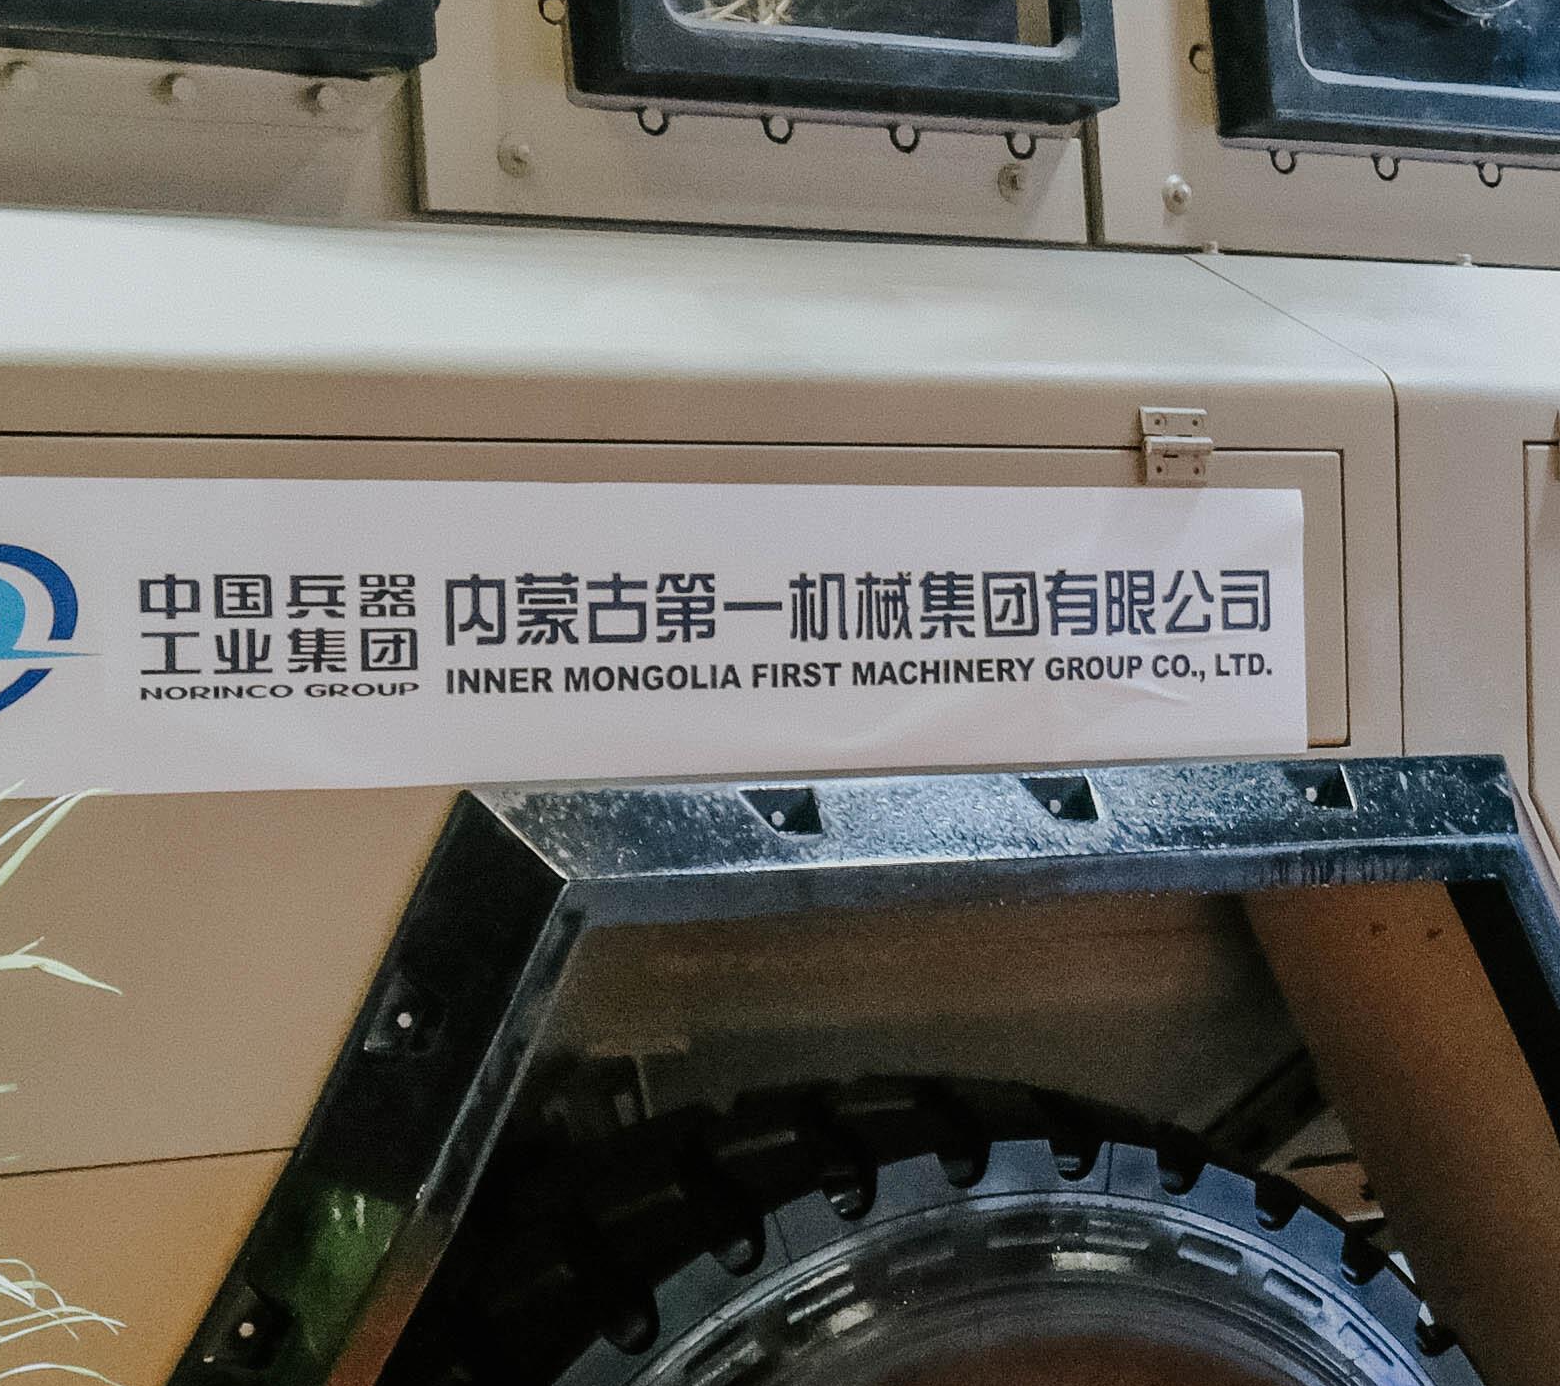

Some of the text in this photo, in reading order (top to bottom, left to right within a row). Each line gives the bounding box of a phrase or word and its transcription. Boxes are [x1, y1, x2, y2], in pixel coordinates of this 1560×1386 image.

[138, 573, 416, 619] 中国兵器
[445, 569, 1272, 647] 内蒙古第一机械集团有限公司
[139, 627, 420, 675] 工业集团
[446, 652, 1273, 694] INNER MONGOLIA FIRST MACHINERY GROUP CO., LTD.
[139, 681, 421, 701] NORINCO GROUP
